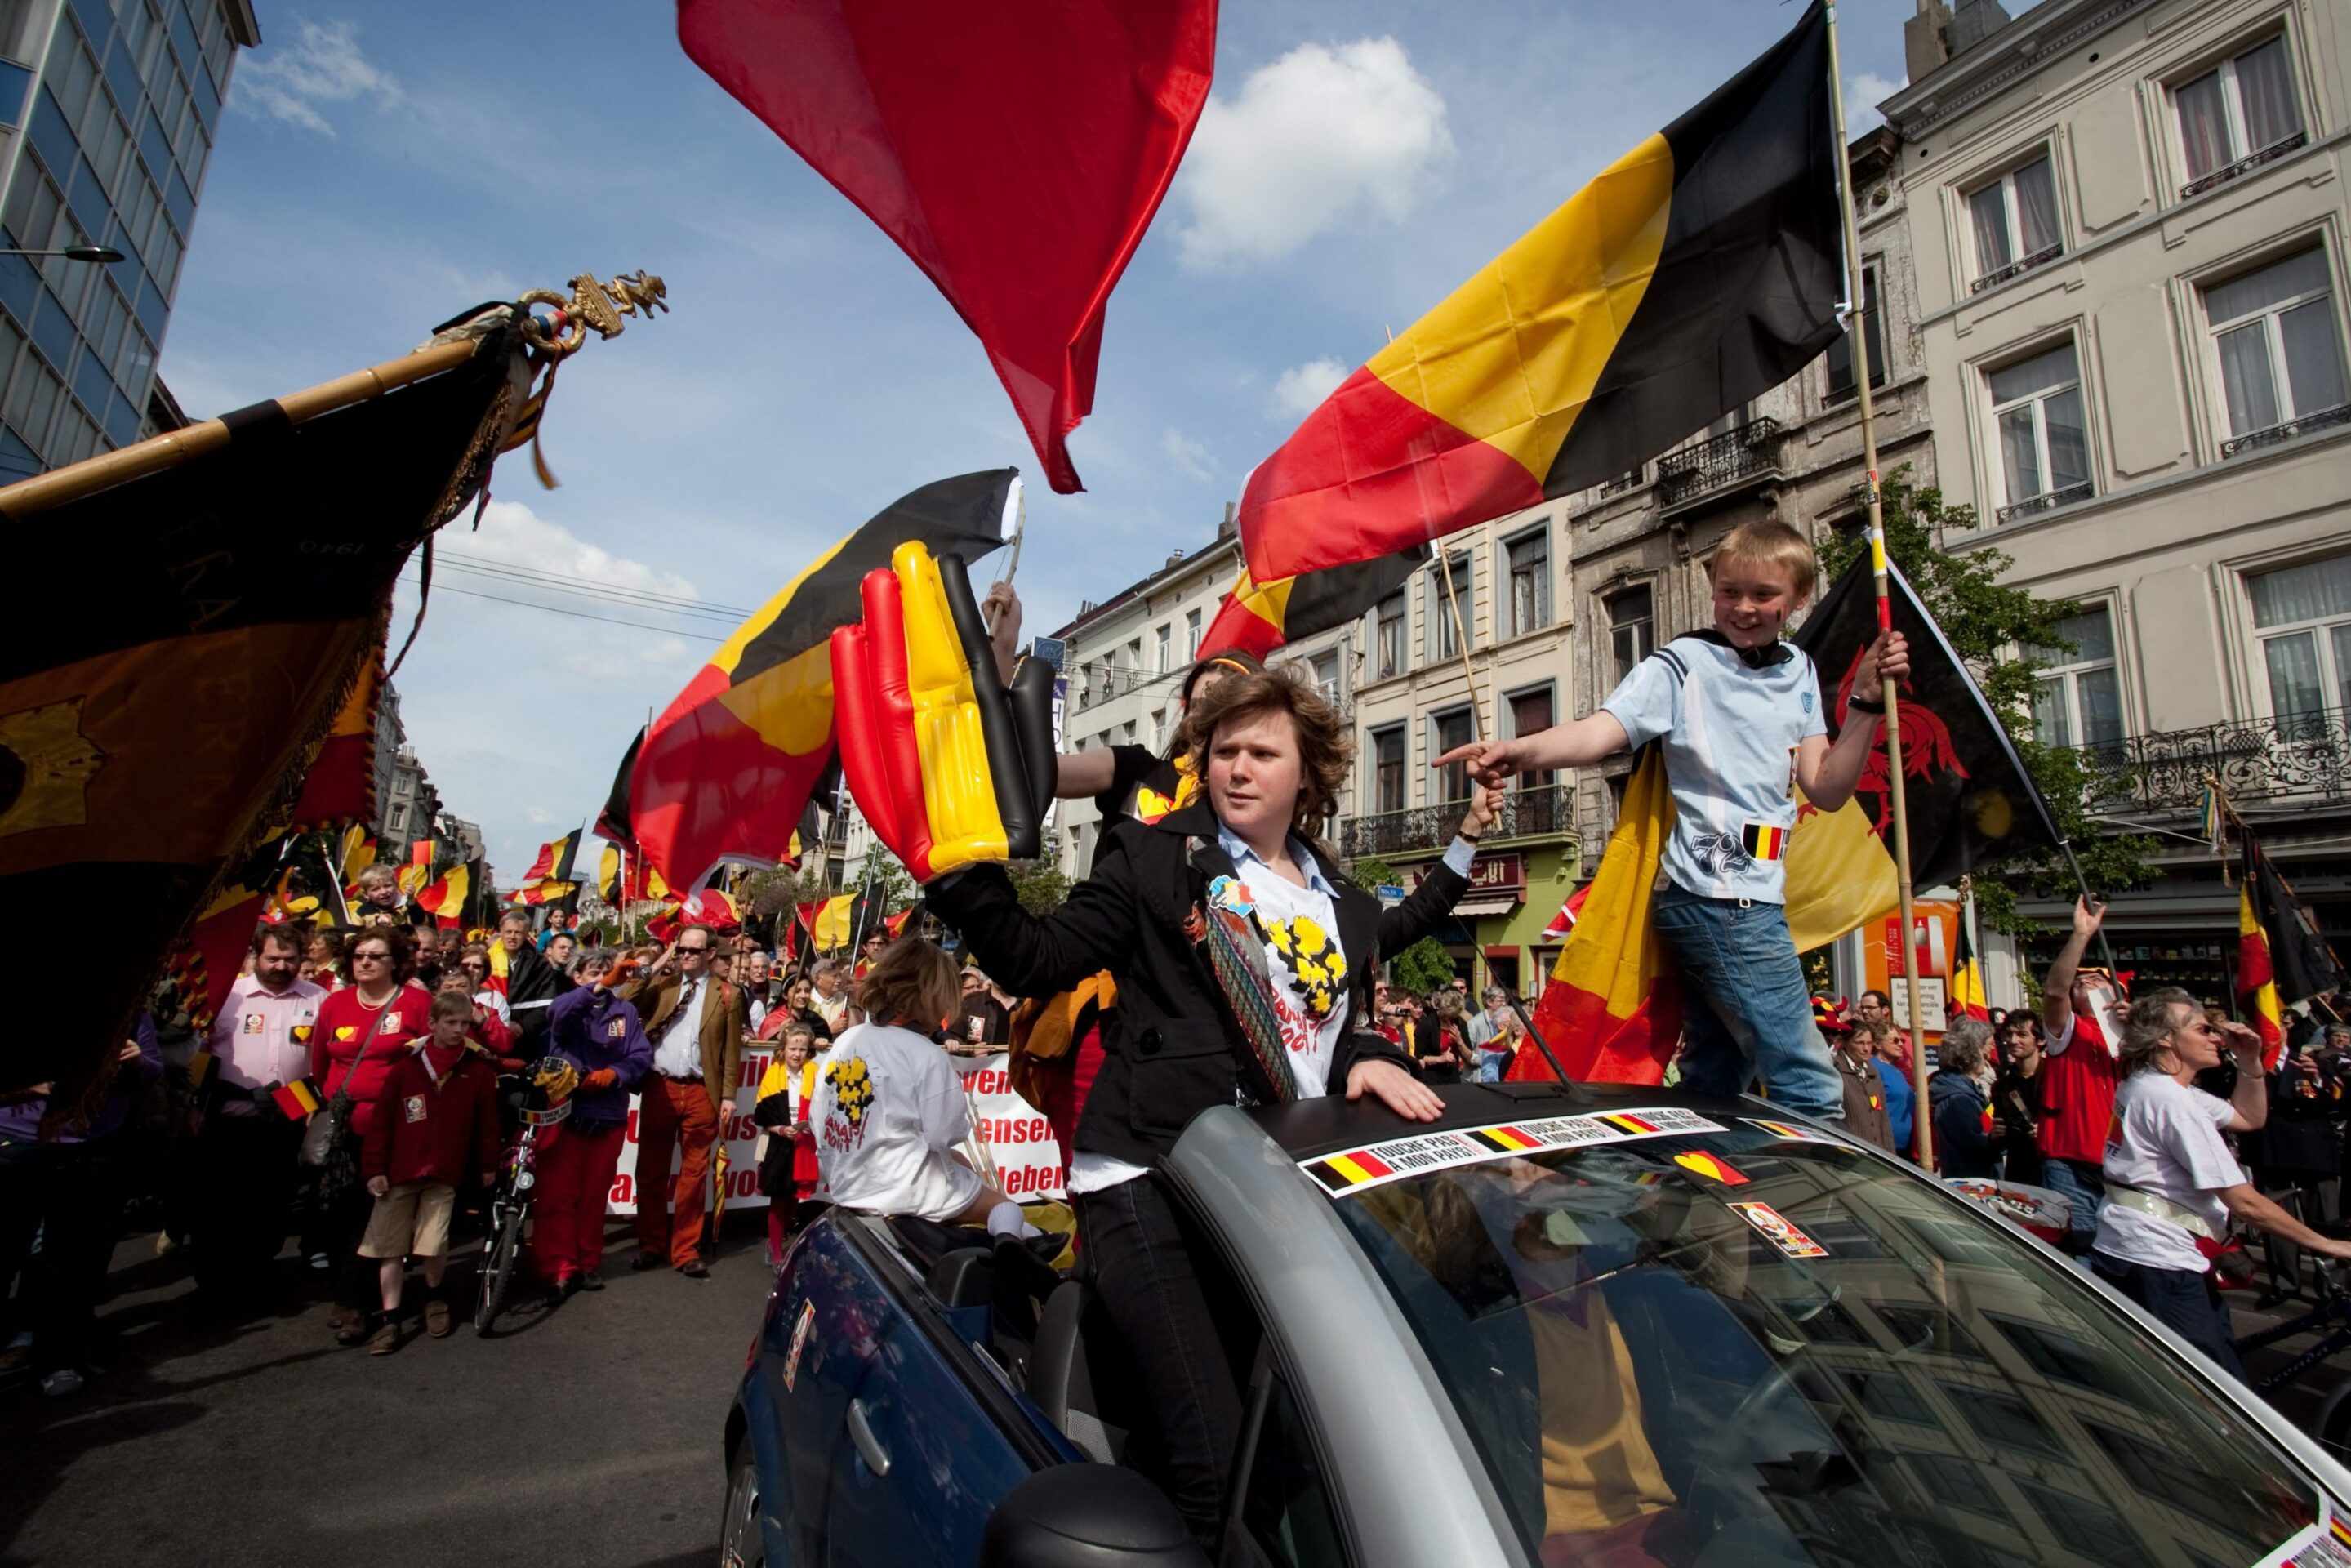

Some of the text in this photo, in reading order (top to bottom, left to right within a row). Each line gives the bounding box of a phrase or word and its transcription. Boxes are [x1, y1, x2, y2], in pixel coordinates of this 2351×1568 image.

[1691, 831, 1751, 876] 72
[1516, 1120, 1570, 1136] TOUCHE
[1561, 1119, 1594, 1130] PAS
[1545, 1132, 1581, 1145] MON
[1369, 1140, 1427, 1161] TOUCHE
[1427, 1134, 1459, 1150] PAS
[1403, 1152, 1436, 1169] MON
[1435, 1146, 1477, 1162] PAYS!
